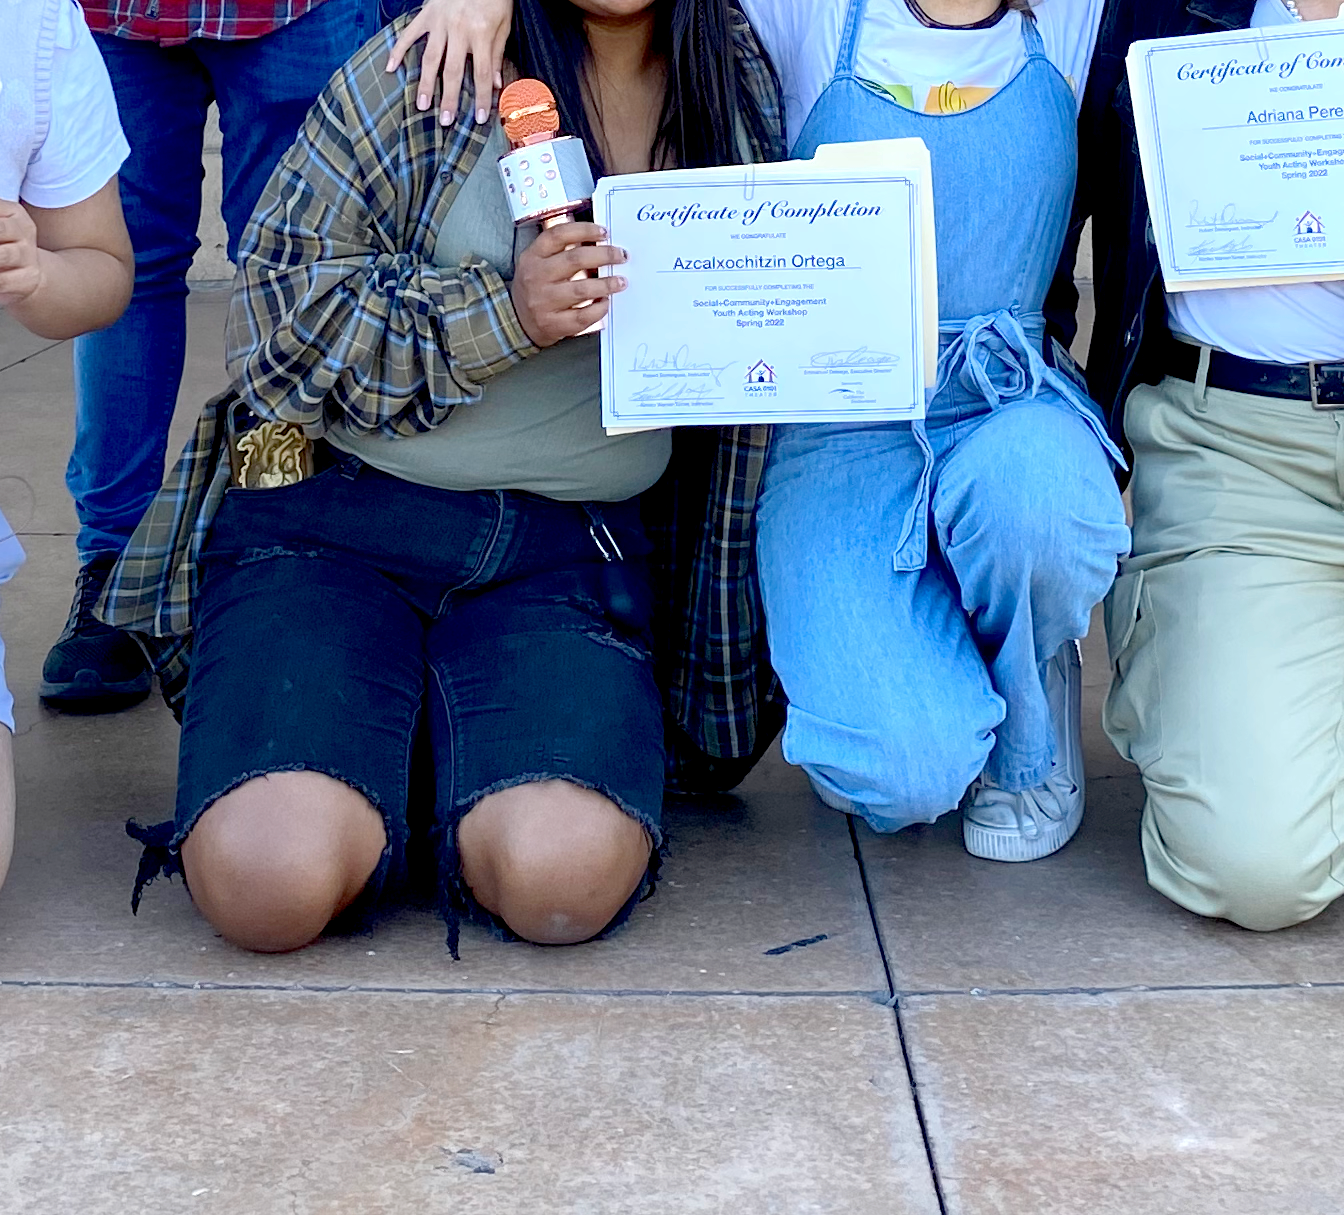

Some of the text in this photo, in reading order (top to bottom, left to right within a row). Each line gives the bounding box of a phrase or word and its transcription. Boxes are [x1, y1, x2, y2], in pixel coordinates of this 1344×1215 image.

[1177, 59, 1274, 85] Certificate
[1278, 53, 1308, 79] of
[1246, 109, 1305, 124] Adriana
[1258, 162, 1281, 171] Youth
[1282, 160, 1308, 169] Acting
[1281, 168, 1328, 181] Spring 2022
[636, 199, 881, 228] Certificate of Completion
[672, 254, 846, 271] Azcalxochitzin Ortega
[712, 308, 808, 318] Youth Acting Workshop
[736, 318, 785, 329] Spring 2022
